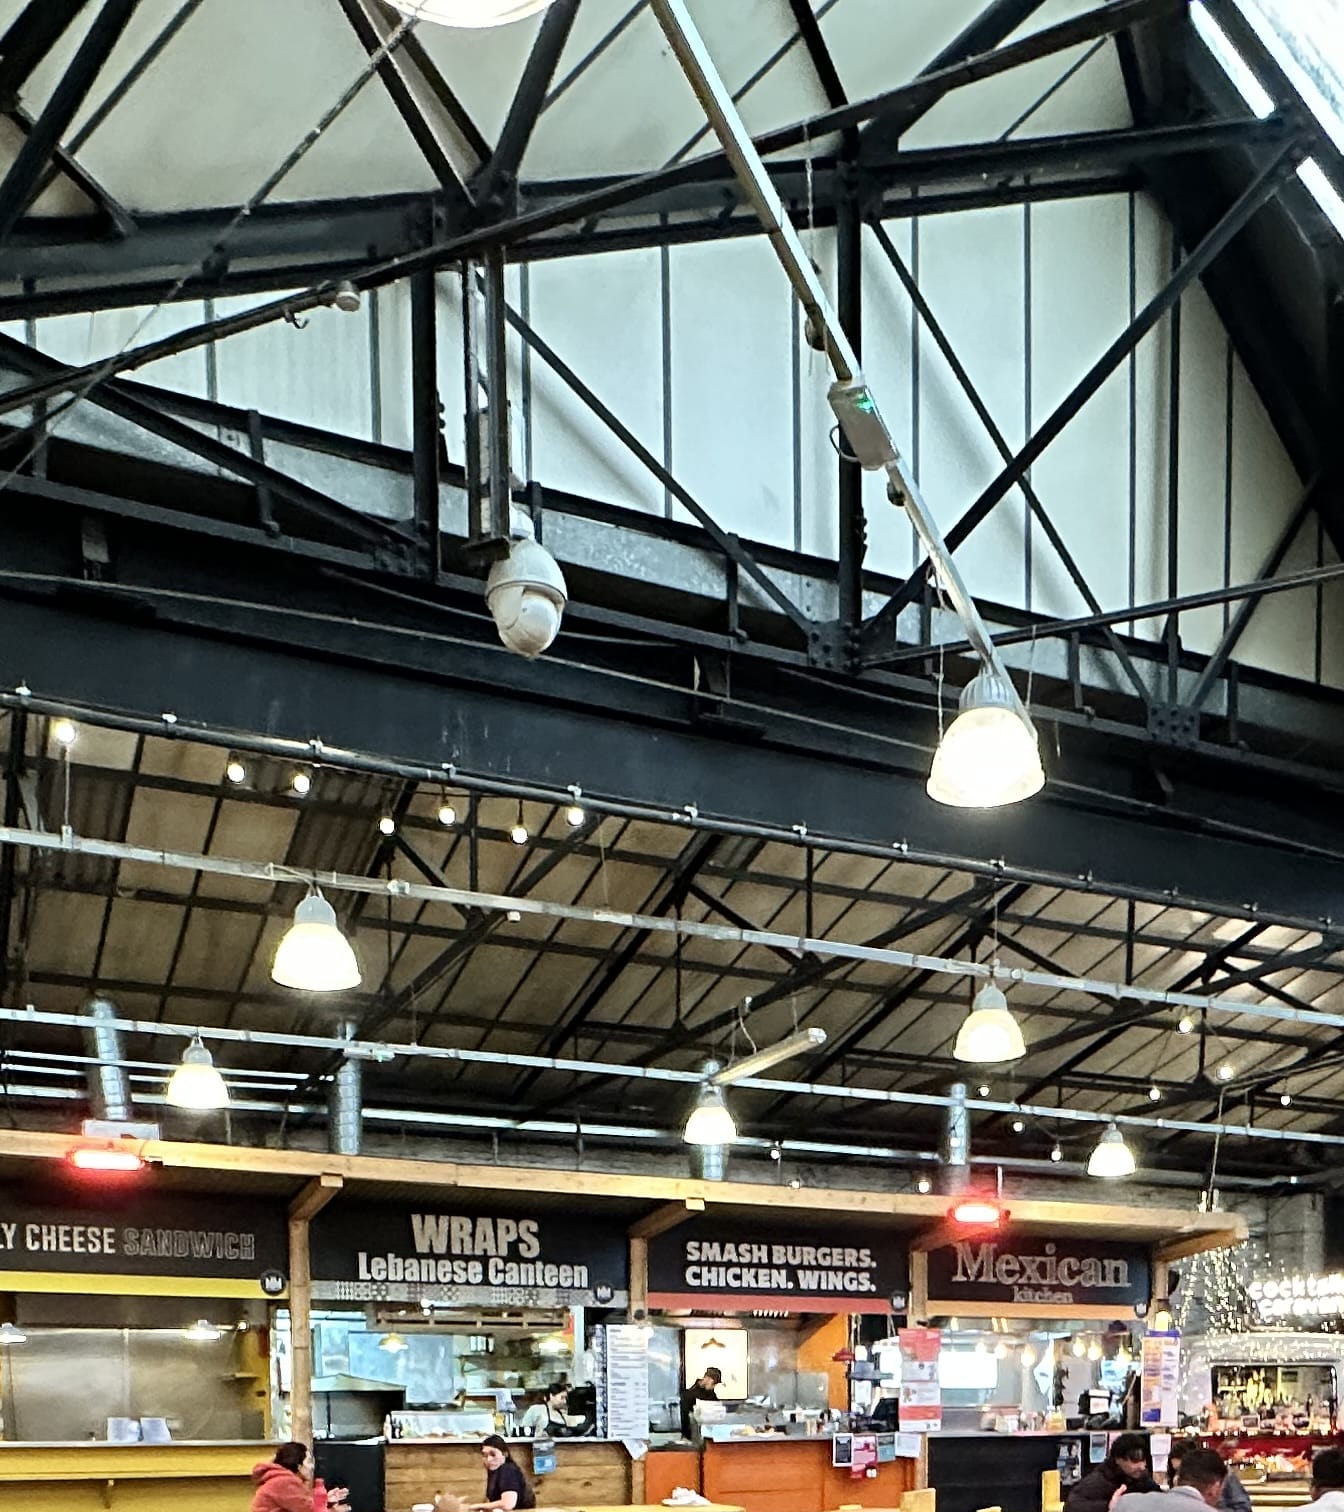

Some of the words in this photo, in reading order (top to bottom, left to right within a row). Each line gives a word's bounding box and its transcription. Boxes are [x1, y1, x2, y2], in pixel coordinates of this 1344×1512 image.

[25, 1223, 116, 1254] CHEESE
[123, 1227, 255, 1260] SANDWICH
[411, 1213, 540, 1258] WRAPS
[358, 1252, 483, 1285] Lebanese
[488, 1257, 588, 1288] Canteen
[686, 1241, 768, 1264] SMASH
[771, 1245, 877, 1268] BURGERS.
[952, 1242, 1132, 1288] Mexican
[685, 1266, 794, 1289] CHICKEN.
[797, 1270, 877, 1292] WINGS.
